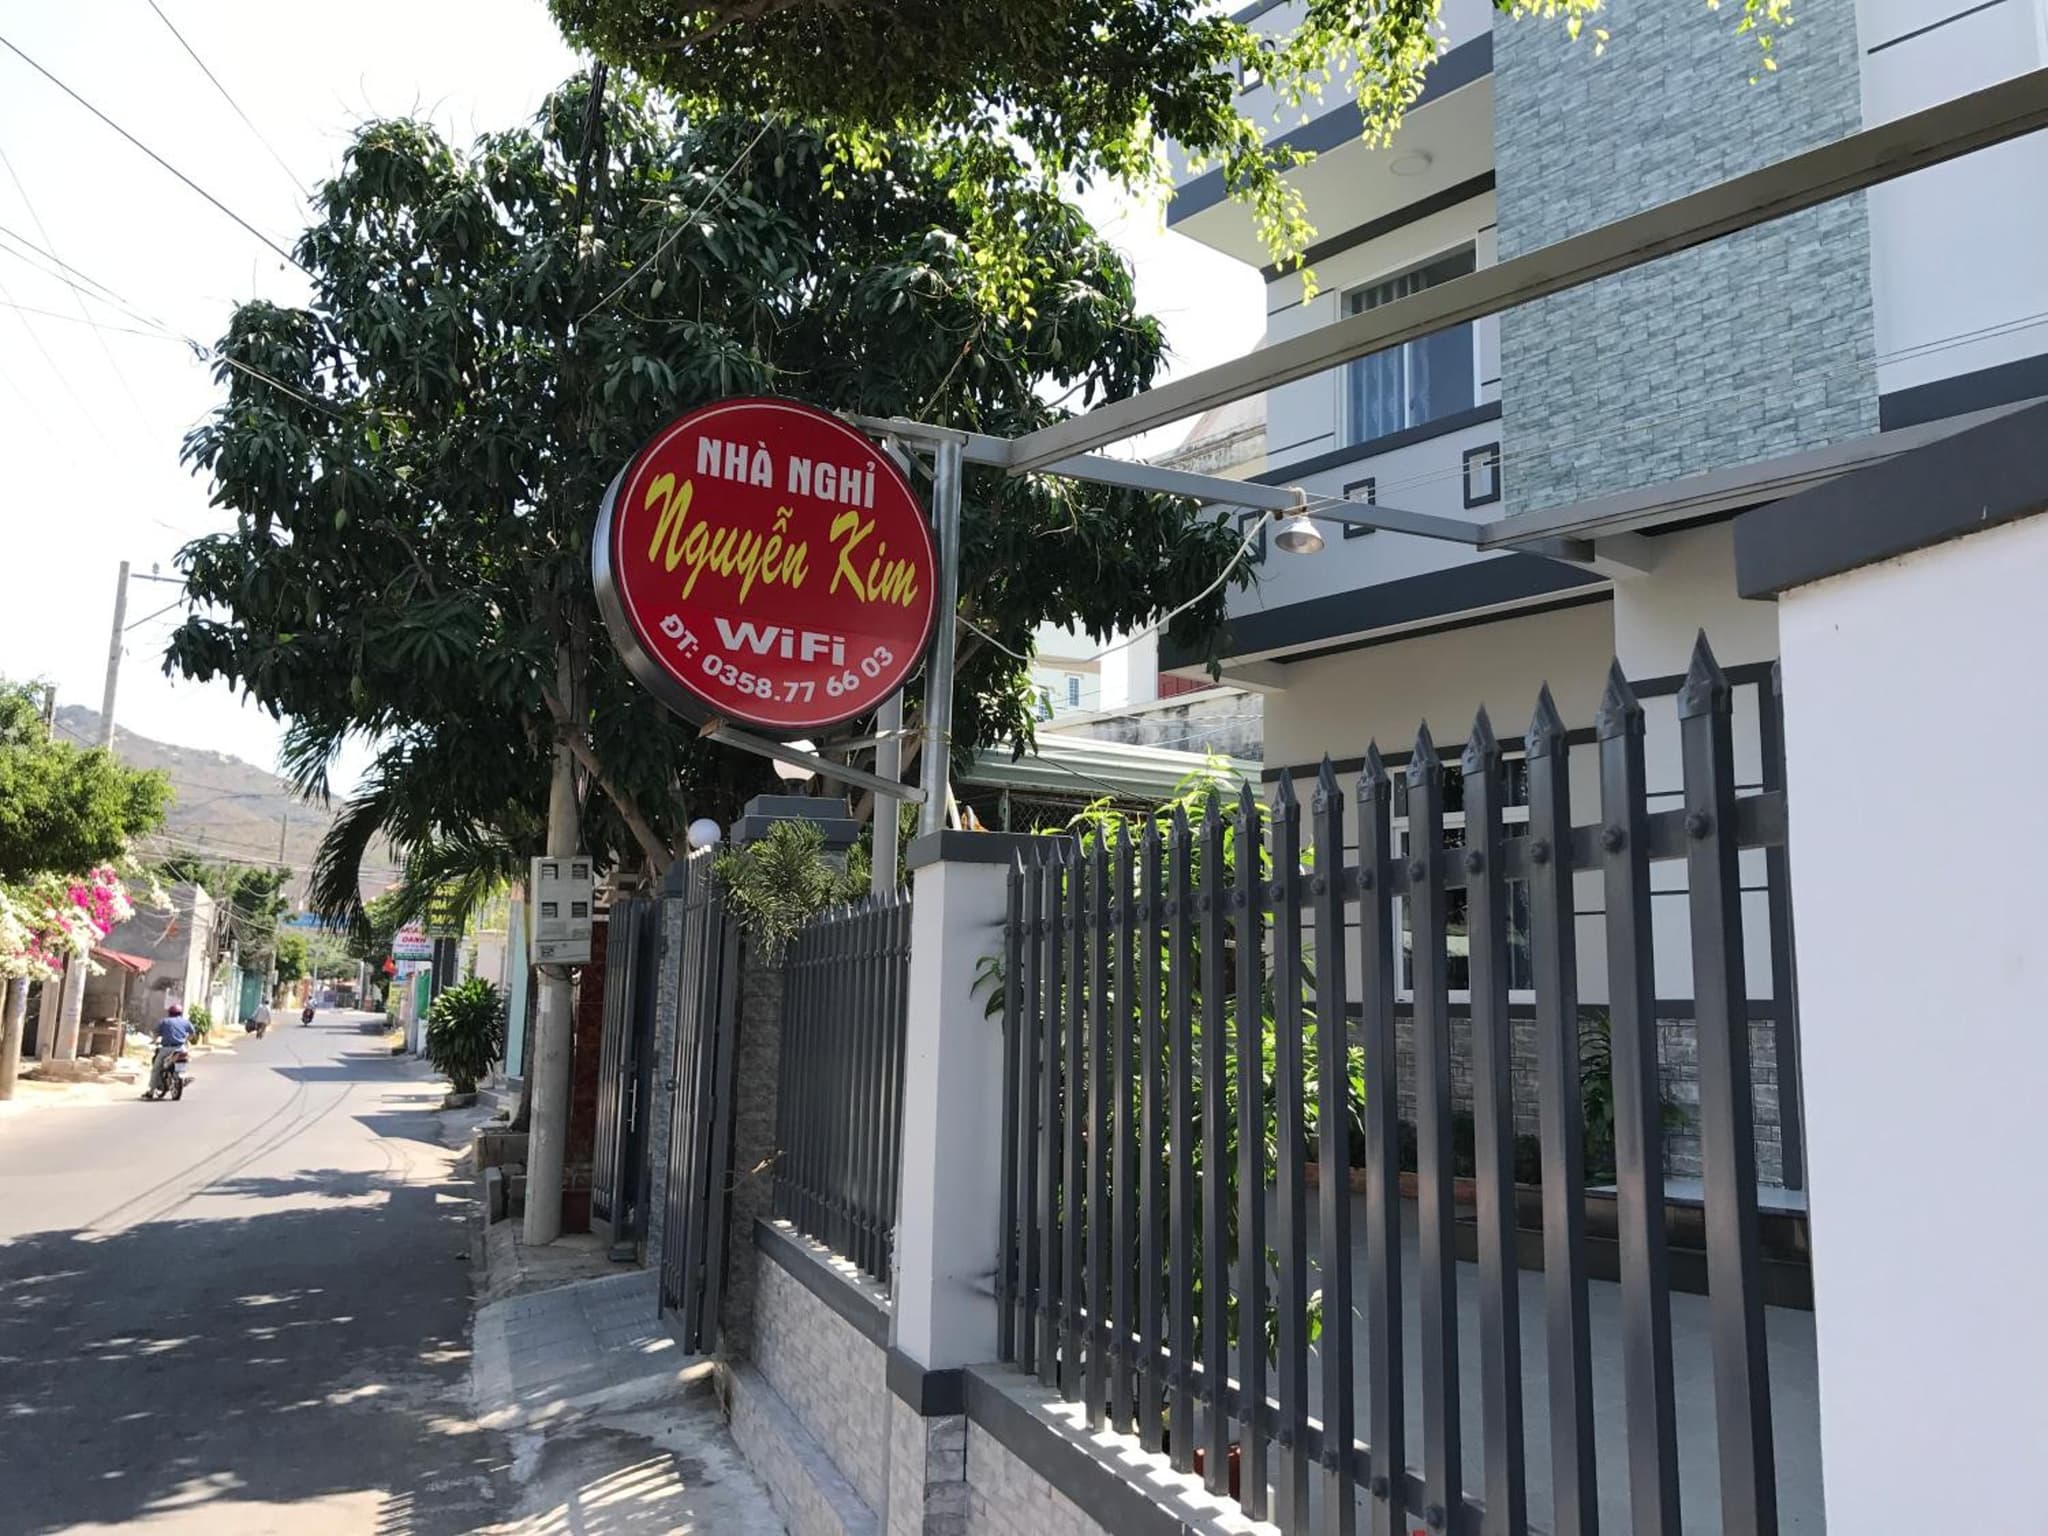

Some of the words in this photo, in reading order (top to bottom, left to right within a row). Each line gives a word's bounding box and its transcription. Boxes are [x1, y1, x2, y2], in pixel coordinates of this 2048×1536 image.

[696, 436, 774, 489] NHÀ
[787, 455, 877, 509] NGHỈ
[644, 472, 809, 605] Nguyễn
[829, 510, 919, 608] Kim
[658, 613, 700, 659] ĐT:
[702, 653, 816, 703] 0358.77
[826, 670, 860, 698] 66
[860, 646, 895, 678] 03
[714, 616, 846, 667] WiFi
